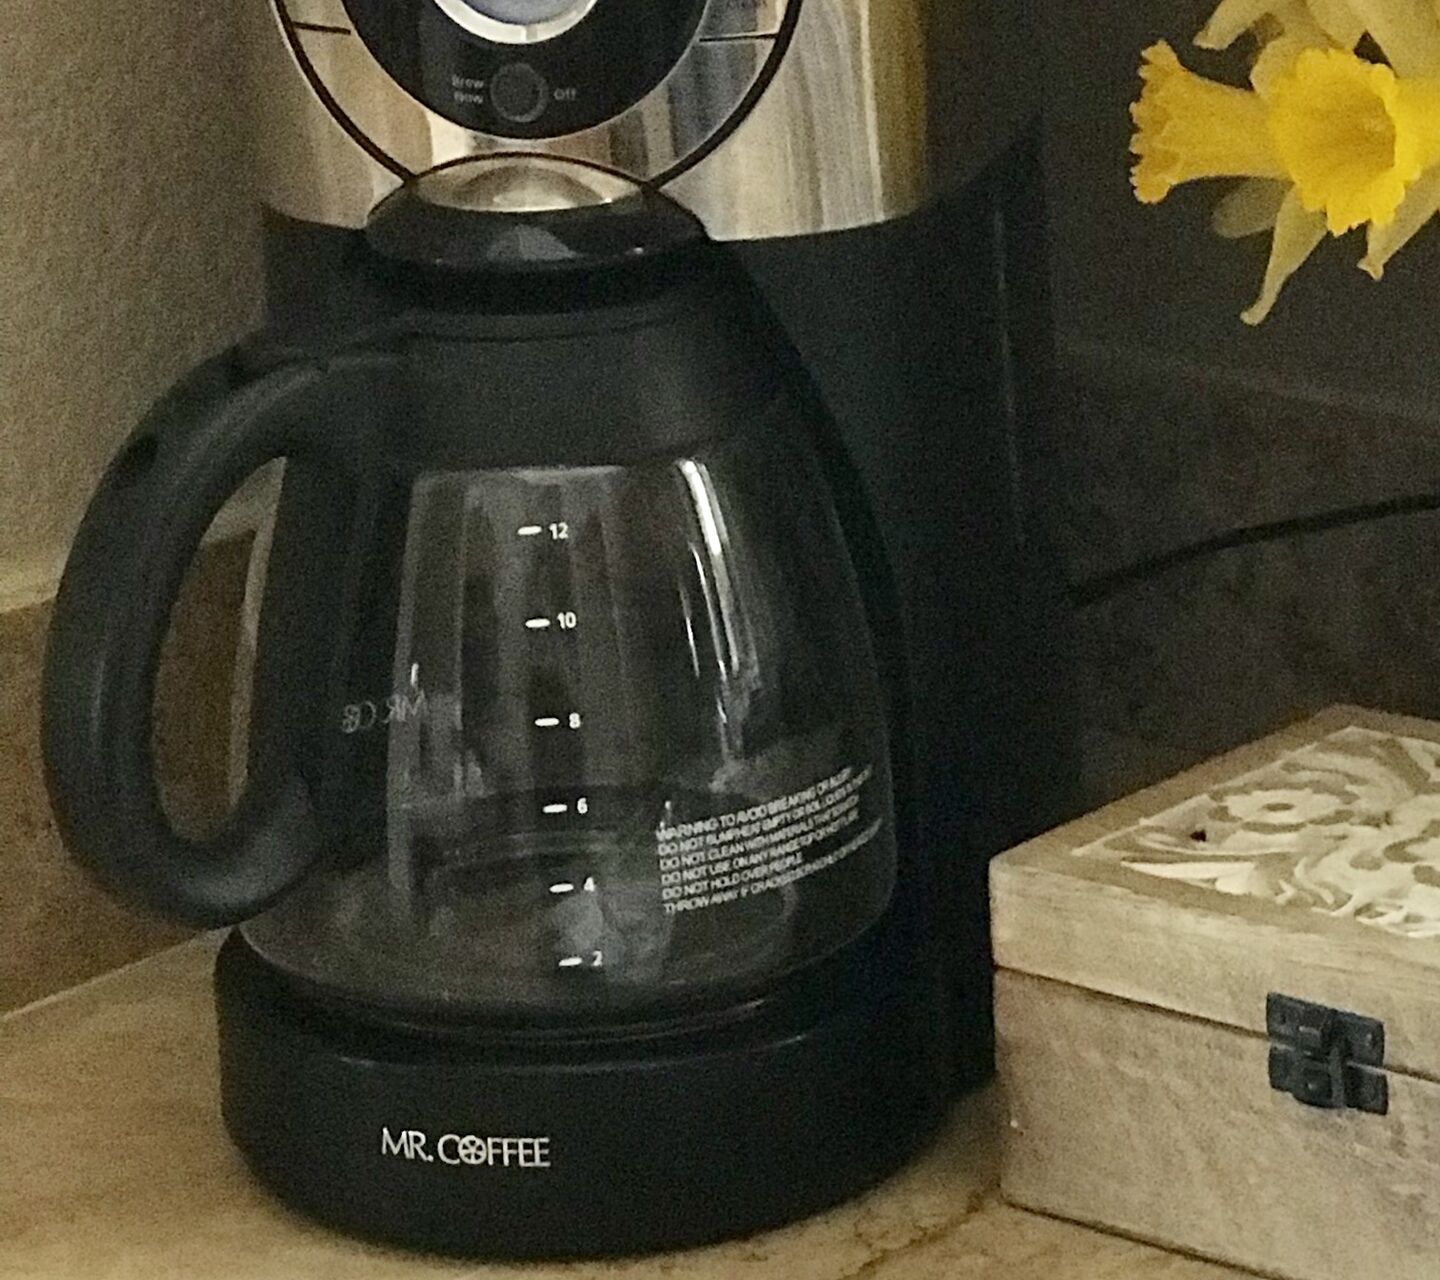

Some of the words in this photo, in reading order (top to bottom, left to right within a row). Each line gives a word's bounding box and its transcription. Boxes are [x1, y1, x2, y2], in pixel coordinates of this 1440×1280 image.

[553, 87, 577, 101] Off
[549, 521, 569, 540] 12
[557, 611, 577, 630] 10
[569, 711, 581, 729] 8
[577, 797, 588, 814] 6
[658, 842, 679, 857] DO
[679, 835, 705, 853] NOT
[660, 856, 680, 871] DO
[681, 851, 706, 867] NOT
[584, 876, 596, 892] 4
[661, 870, 681, 886] DO
[682, 864, 708, 882] NOT
[662, 885, 682, 900] DO
[683, 879, 709, 896] NOT
[592, 949, 603, 967] 2
[381, 1126, 434, 1163] MR.
[437, 1133, 551, 1168] COFFEE
